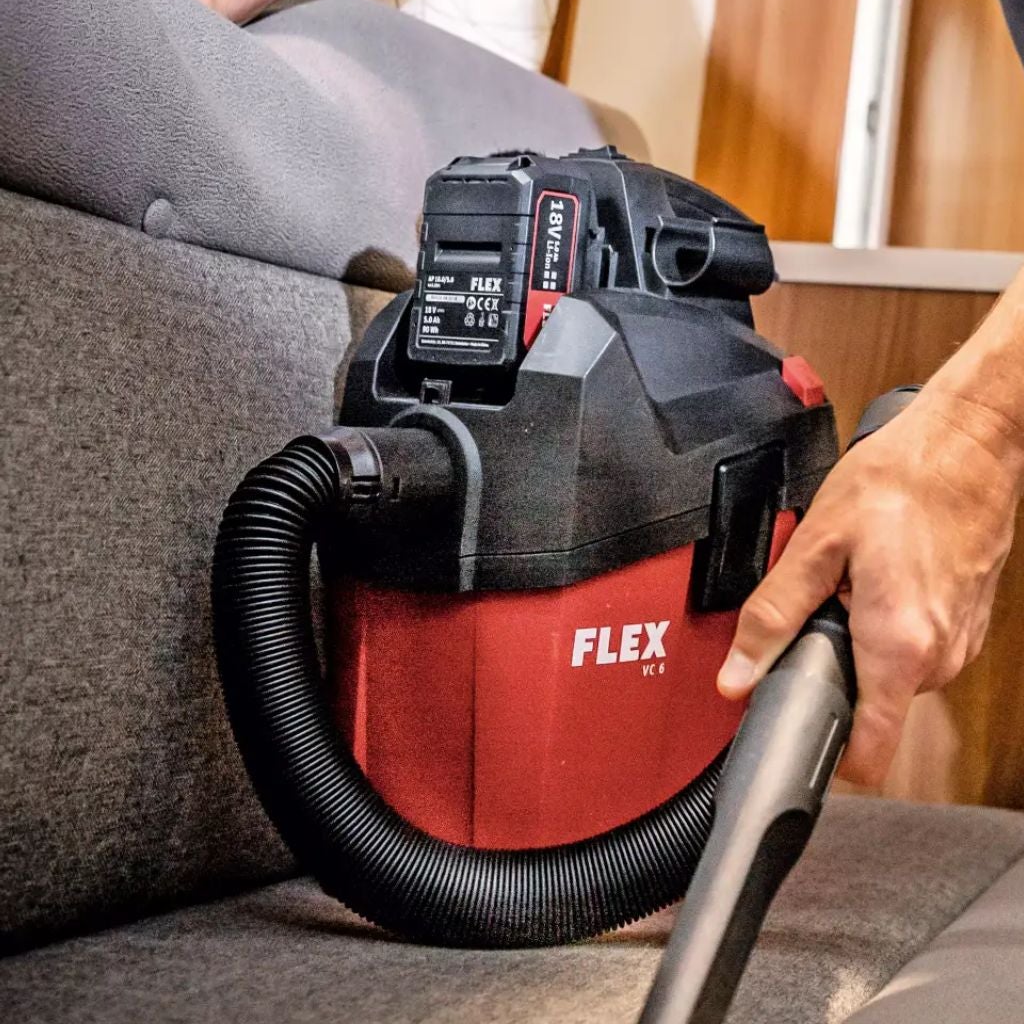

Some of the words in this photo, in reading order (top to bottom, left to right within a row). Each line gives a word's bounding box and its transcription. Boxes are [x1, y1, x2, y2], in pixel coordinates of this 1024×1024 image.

[548, 201, 564, 239] 18V
[470, 277, 502, 292] FLEX
[571, 620, 671, 667] FLEX
[642, 664, 656, 677] VC
[658, 662, 665, 674] 6
